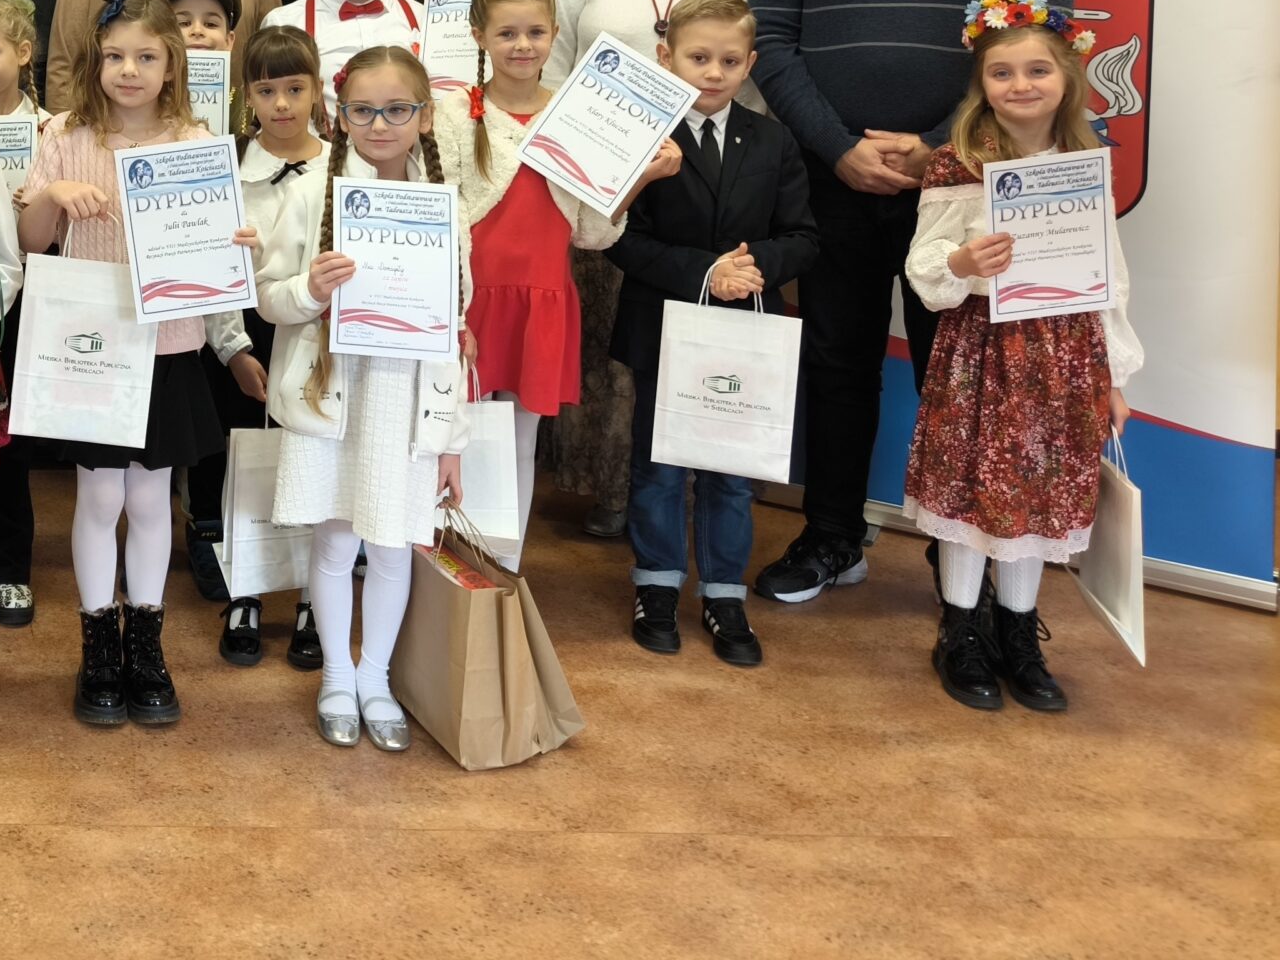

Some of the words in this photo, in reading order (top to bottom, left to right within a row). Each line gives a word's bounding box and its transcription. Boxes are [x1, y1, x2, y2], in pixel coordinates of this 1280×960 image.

[580, 73, 664, 131] DYPLOM
[133, 185, 229, 213] DYPLOM
[1000, 196, 1097, 222] DYPLOM
[347, 227, 443, 248] DYPLOM
